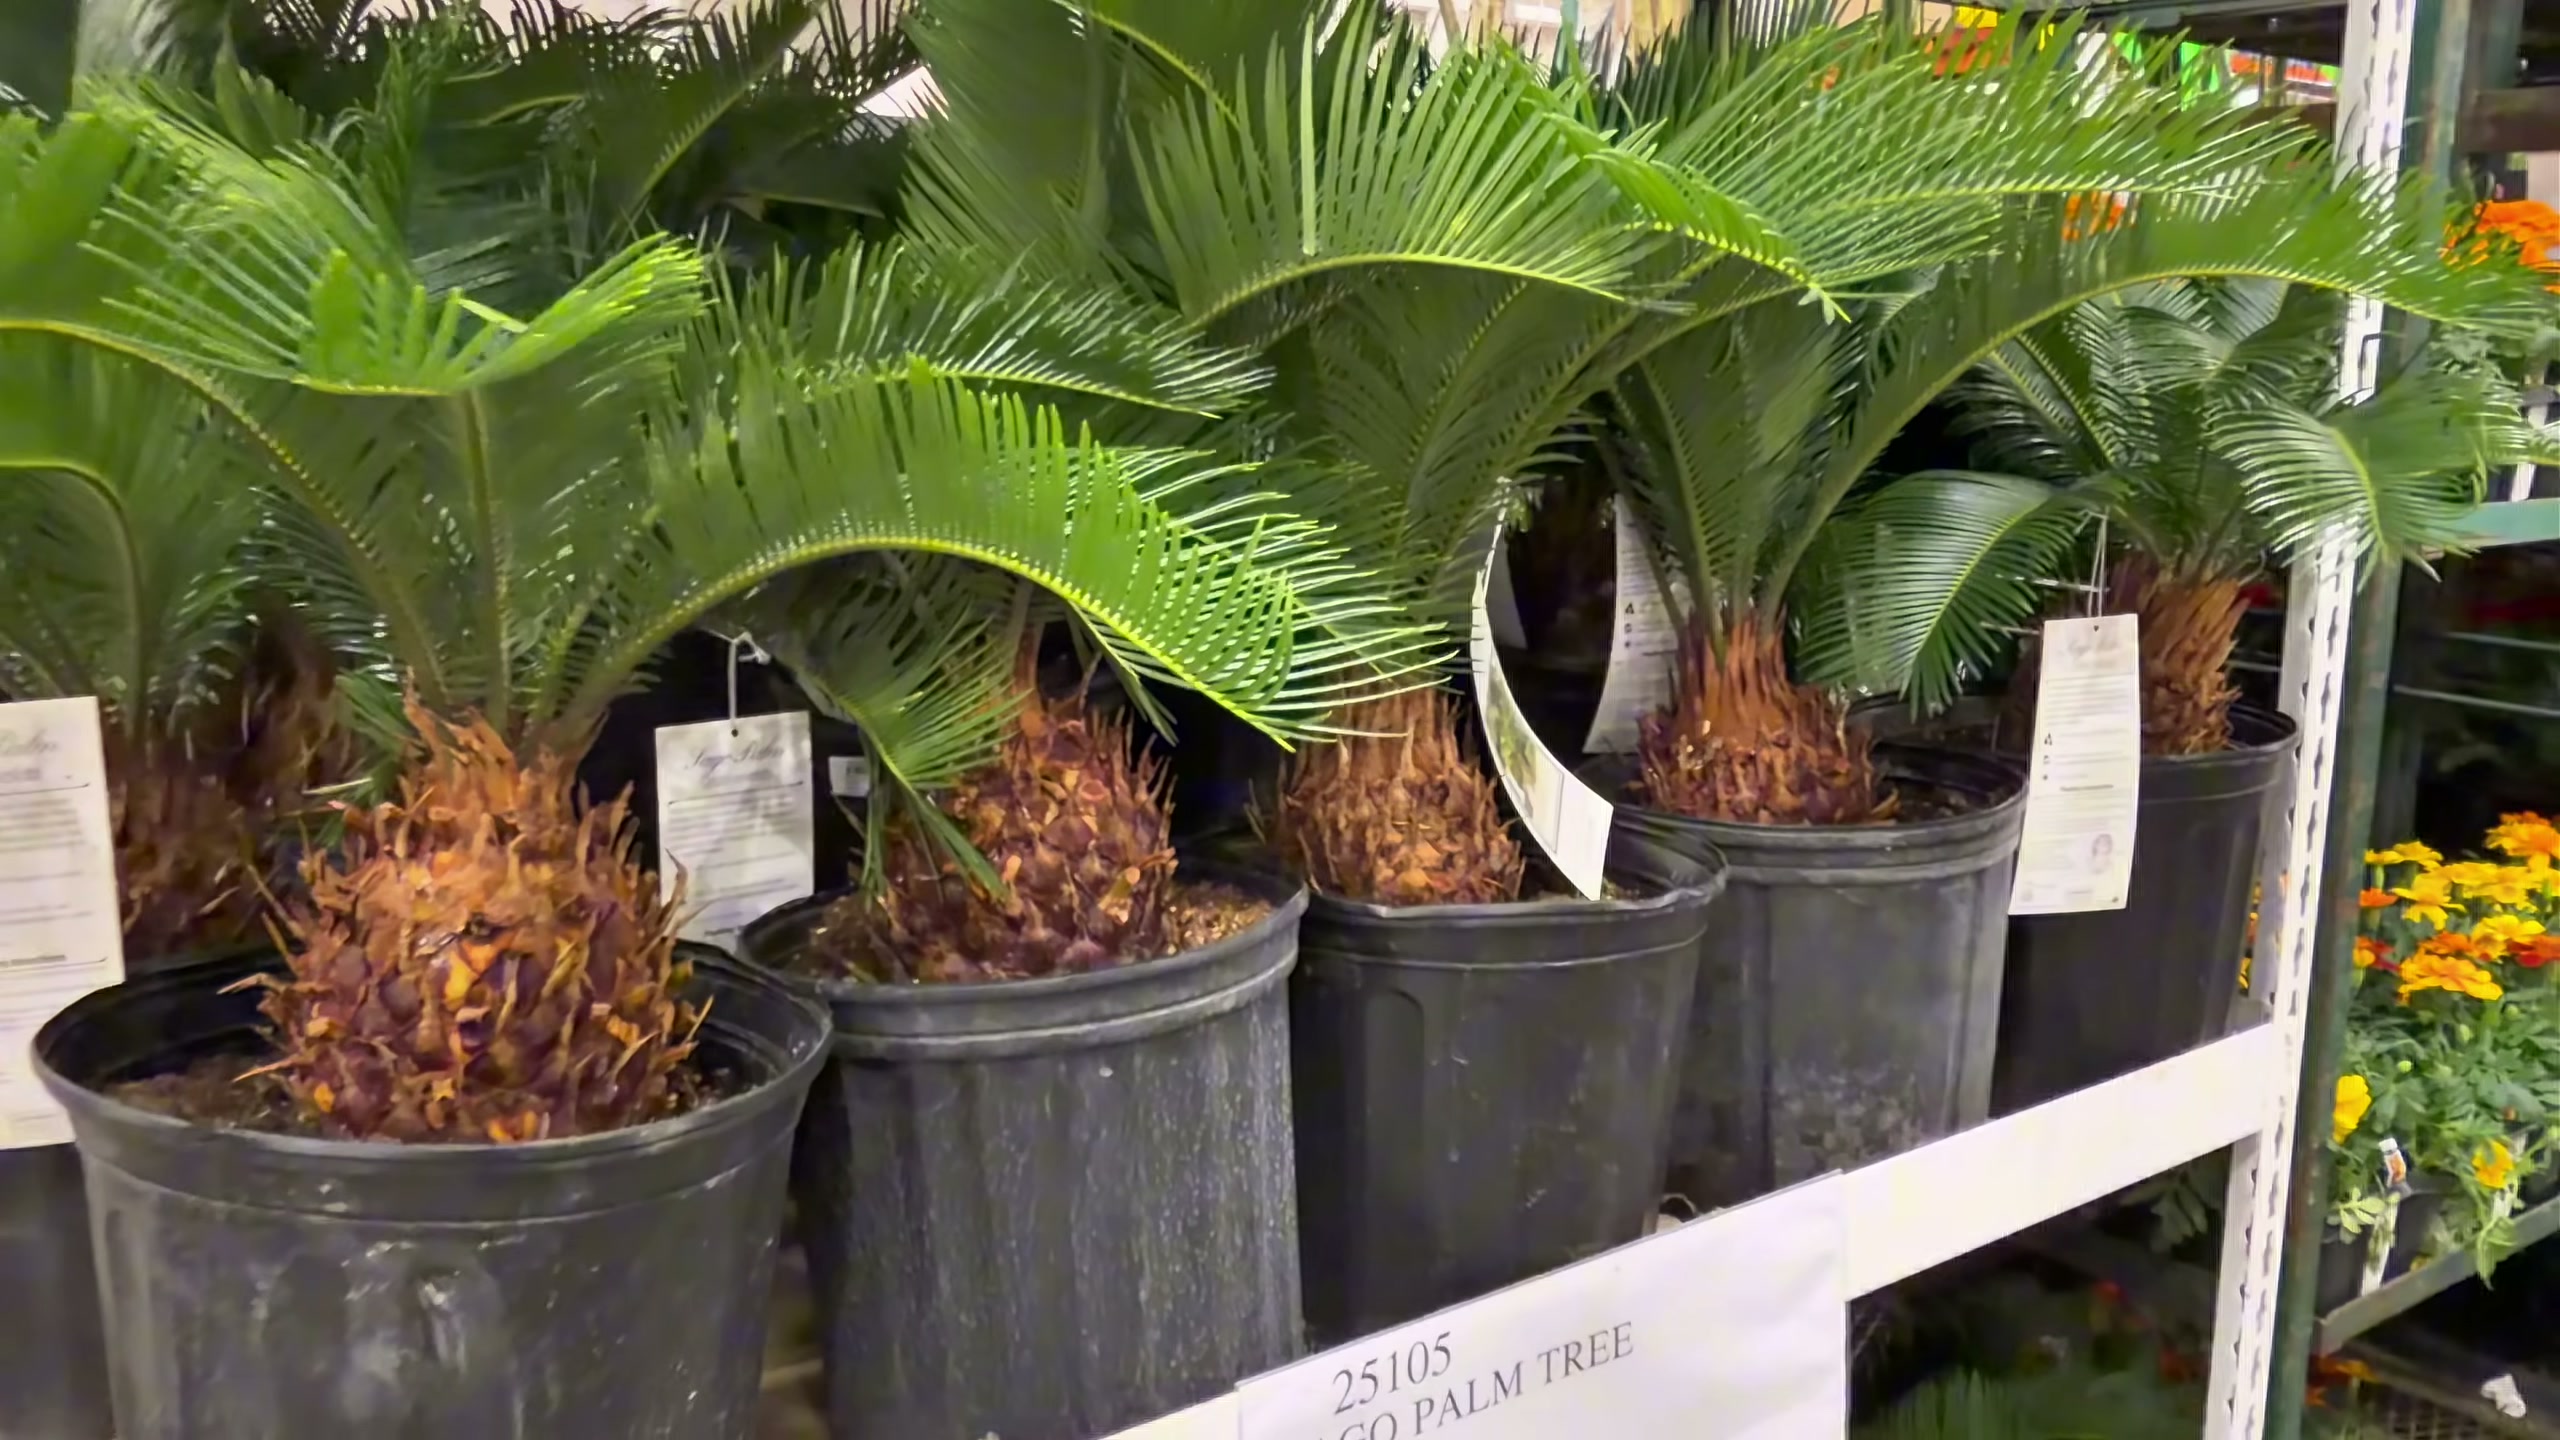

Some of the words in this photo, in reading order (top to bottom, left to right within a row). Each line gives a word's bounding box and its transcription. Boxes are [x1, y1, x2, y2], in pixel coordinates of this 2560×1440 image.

[1332, 1330, 1452, 1415] 25105
[1412, 1360, 1525, 1436] PALM
[1536, 1320, 1634, 1387] TREE
